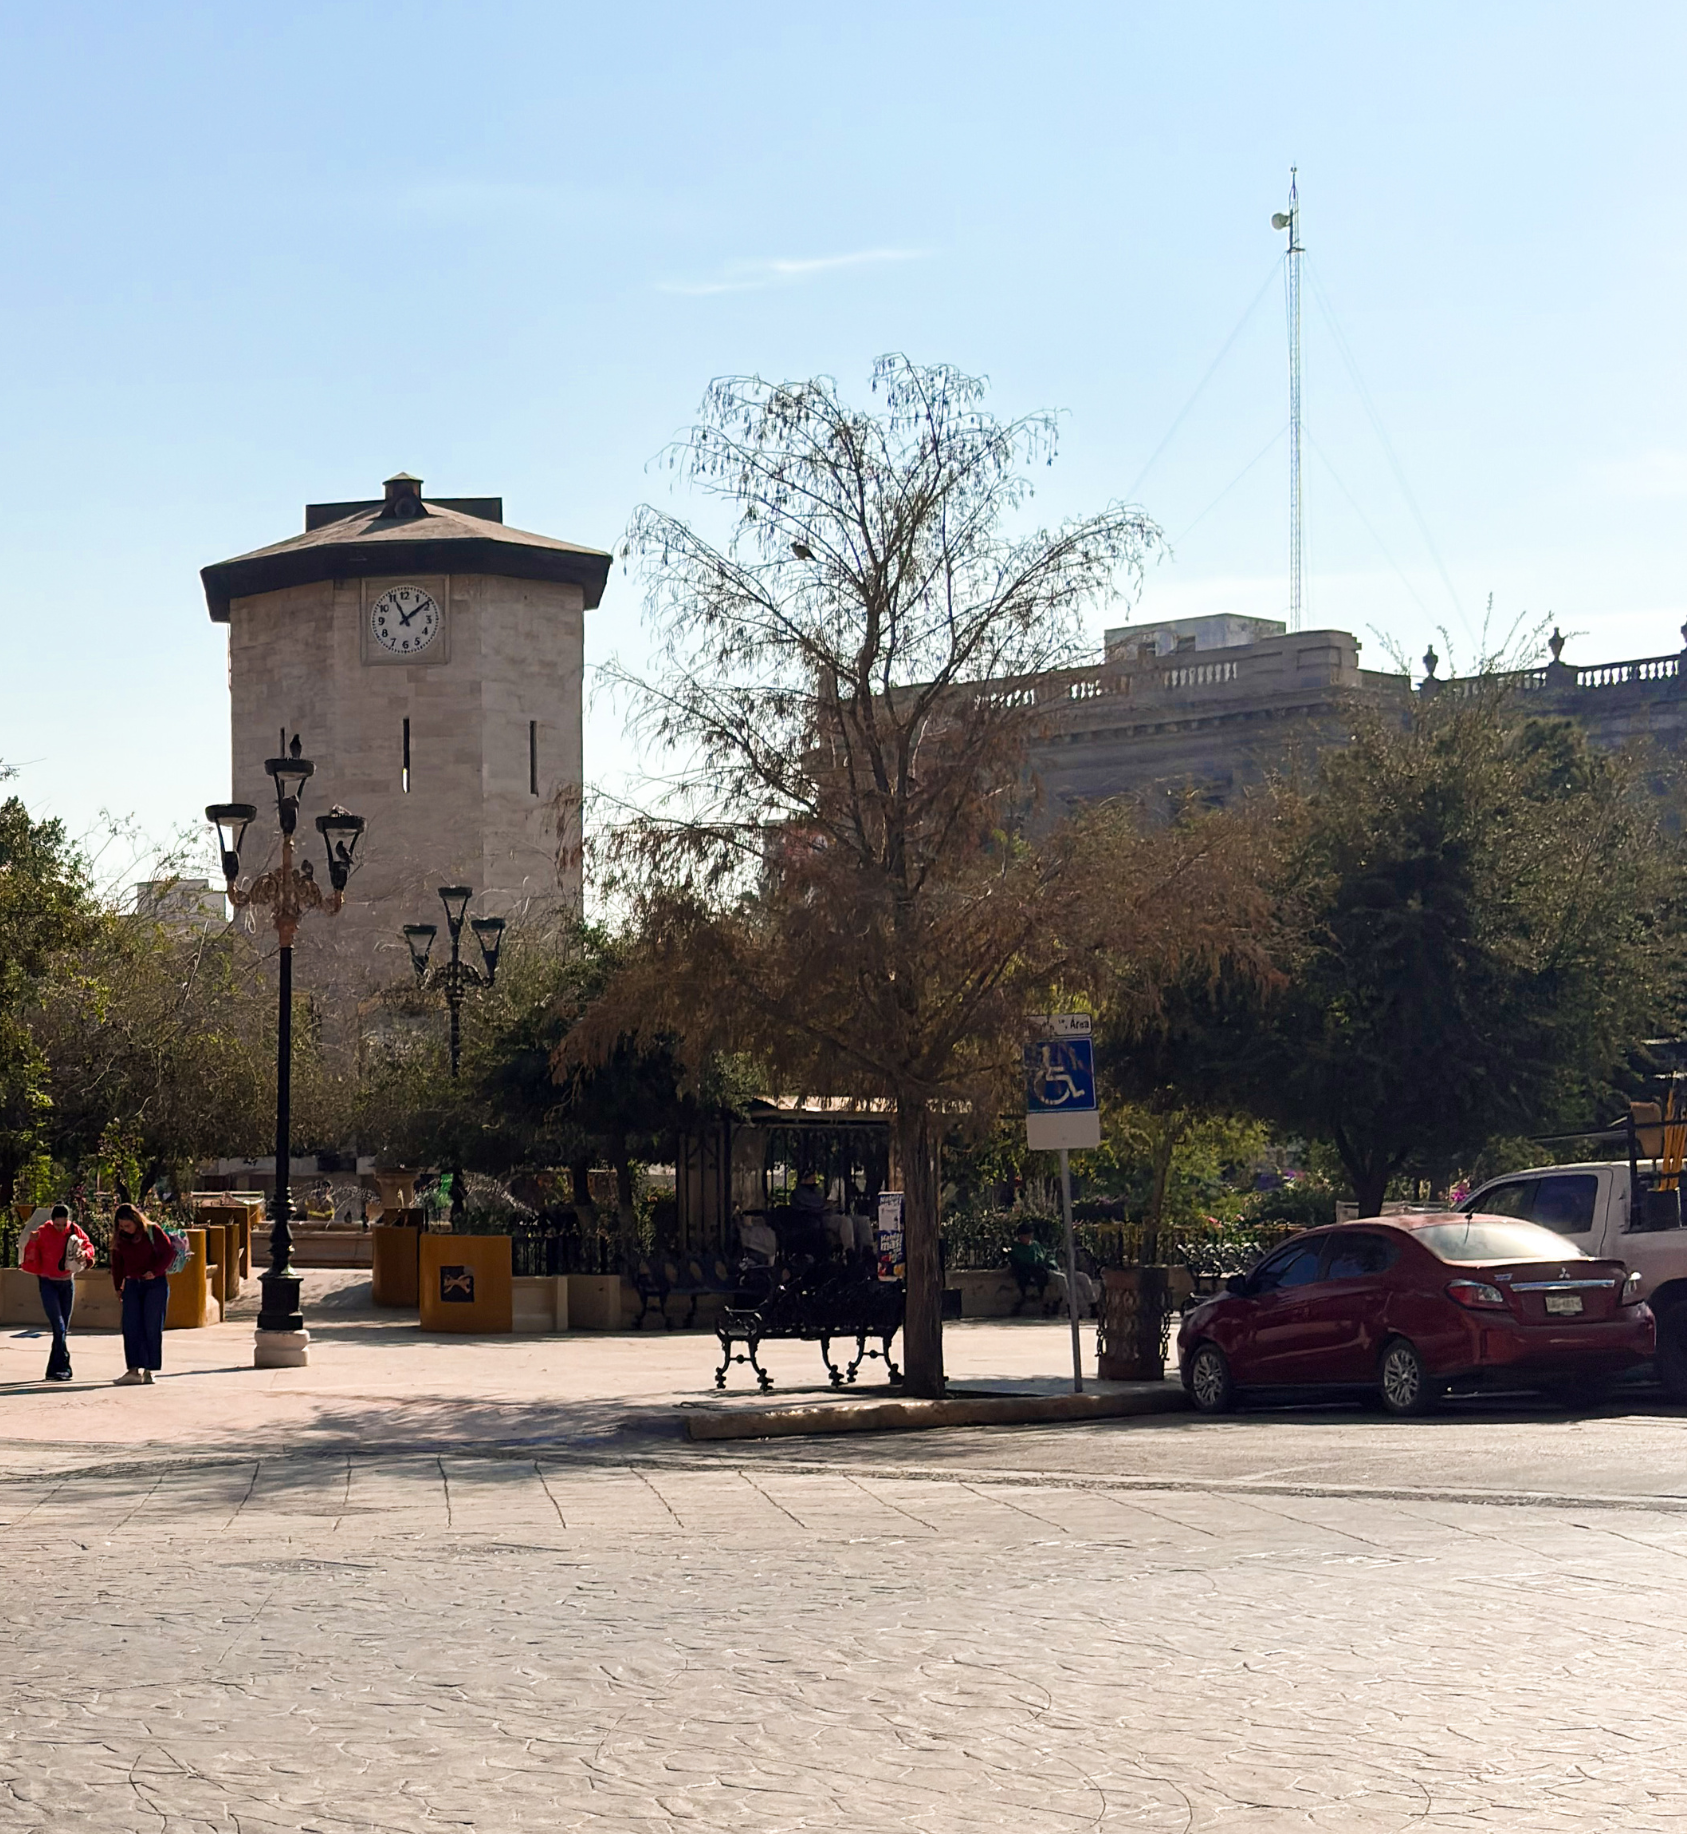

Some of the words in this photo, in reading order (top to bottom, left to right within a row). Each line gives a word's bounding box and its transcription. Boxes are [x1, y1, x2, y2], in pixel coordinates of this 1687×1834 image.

[400, 591, 410, 600] 12
[415, 594, 420, 603] 1
[379, 604, 389, 613] 10
[378, 617, 385, 625] 9
[426, 615, 432, 624] 3
[382, 629, 388, 637] 8
[422, 627, 428, 635] 4
[390, 638, 396, 647] 7
[402, 640, 409, 649] 6
[414, 637, 420, 645] 5
